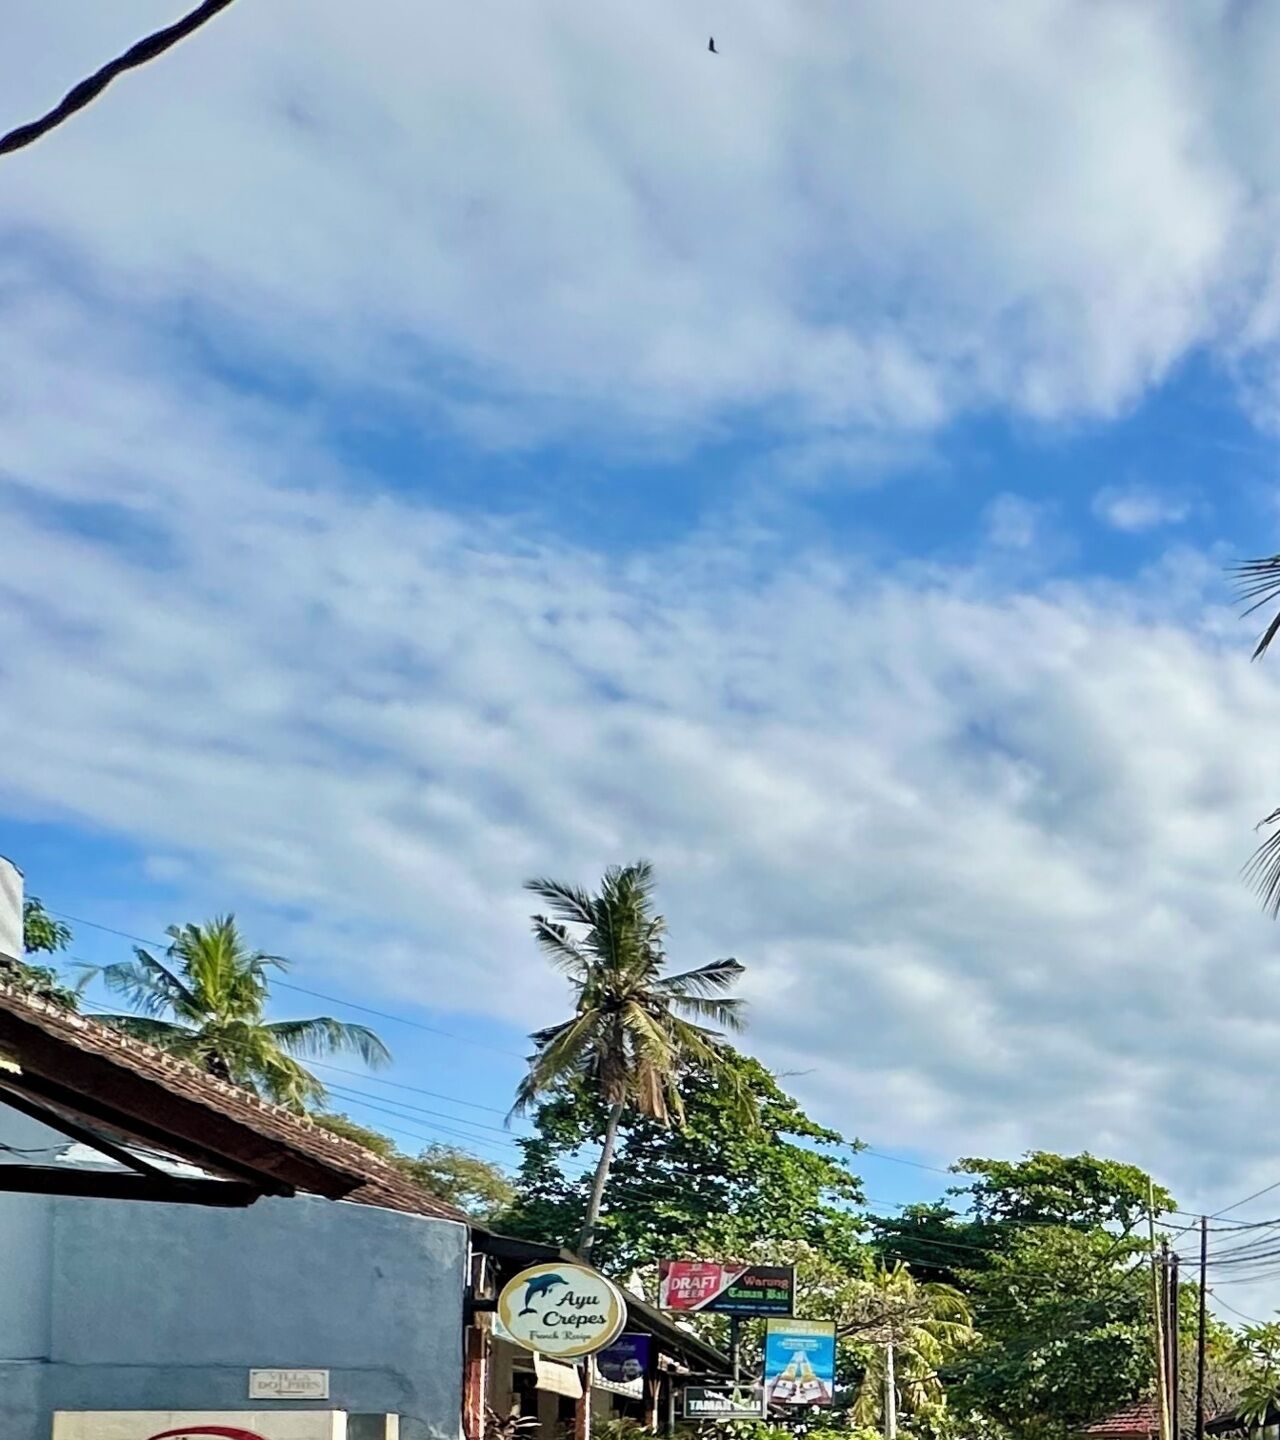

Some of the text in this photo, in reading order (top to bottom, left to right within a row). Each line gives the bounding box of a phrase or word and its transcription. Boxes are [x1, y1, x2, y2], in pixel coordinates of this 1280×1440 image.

[671, 1275, 718, 1291] DRAFT
[743, 1275, 789, 1290] Warung
[556, 1290, 601, 1310] Ayu
[677, 1289, 705, 1299] BEER
[728, 1287, 764, 1299] Taman
